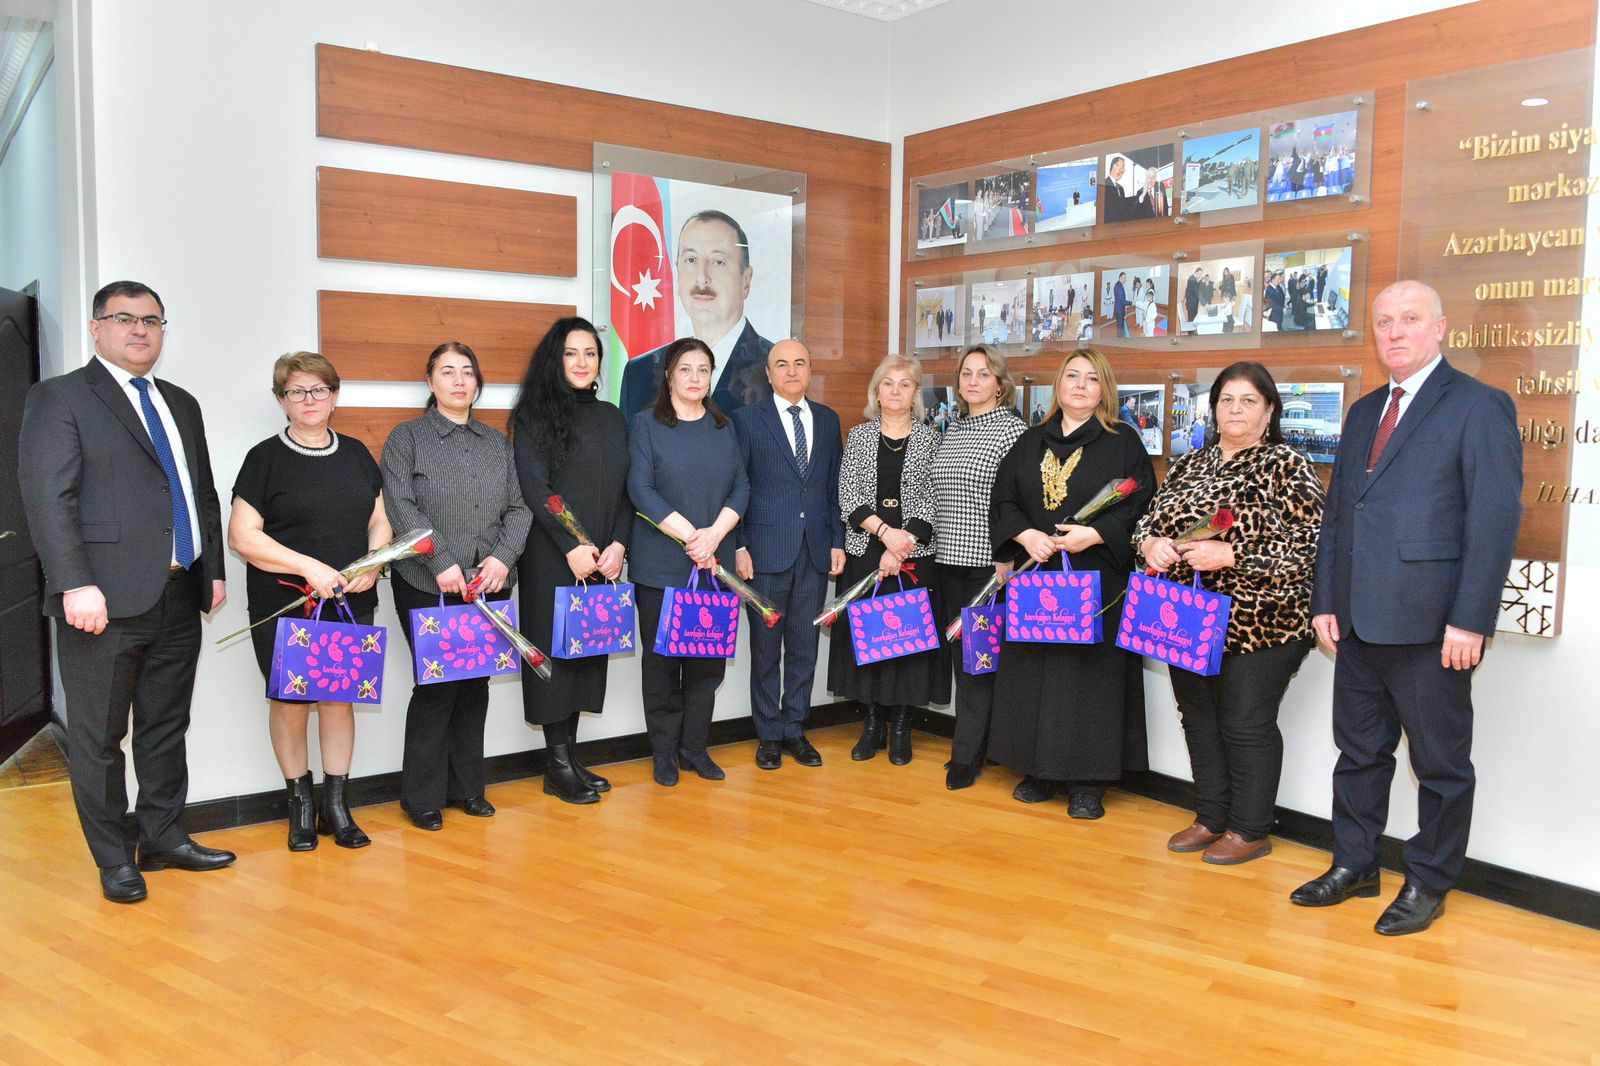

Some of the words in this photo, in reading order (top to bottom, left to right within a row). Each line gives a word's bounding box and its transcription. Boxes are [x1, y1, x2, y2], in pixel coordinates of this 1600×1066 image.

[1442, 227, 1584, 256] Azərbaycan
[1475, 279, 1535, 301] onun
[1543, 276, 1600, 297] mar
[1516, 370, 1580, 395] təhsil
[1536, 480, 1600, 505] İLHA
